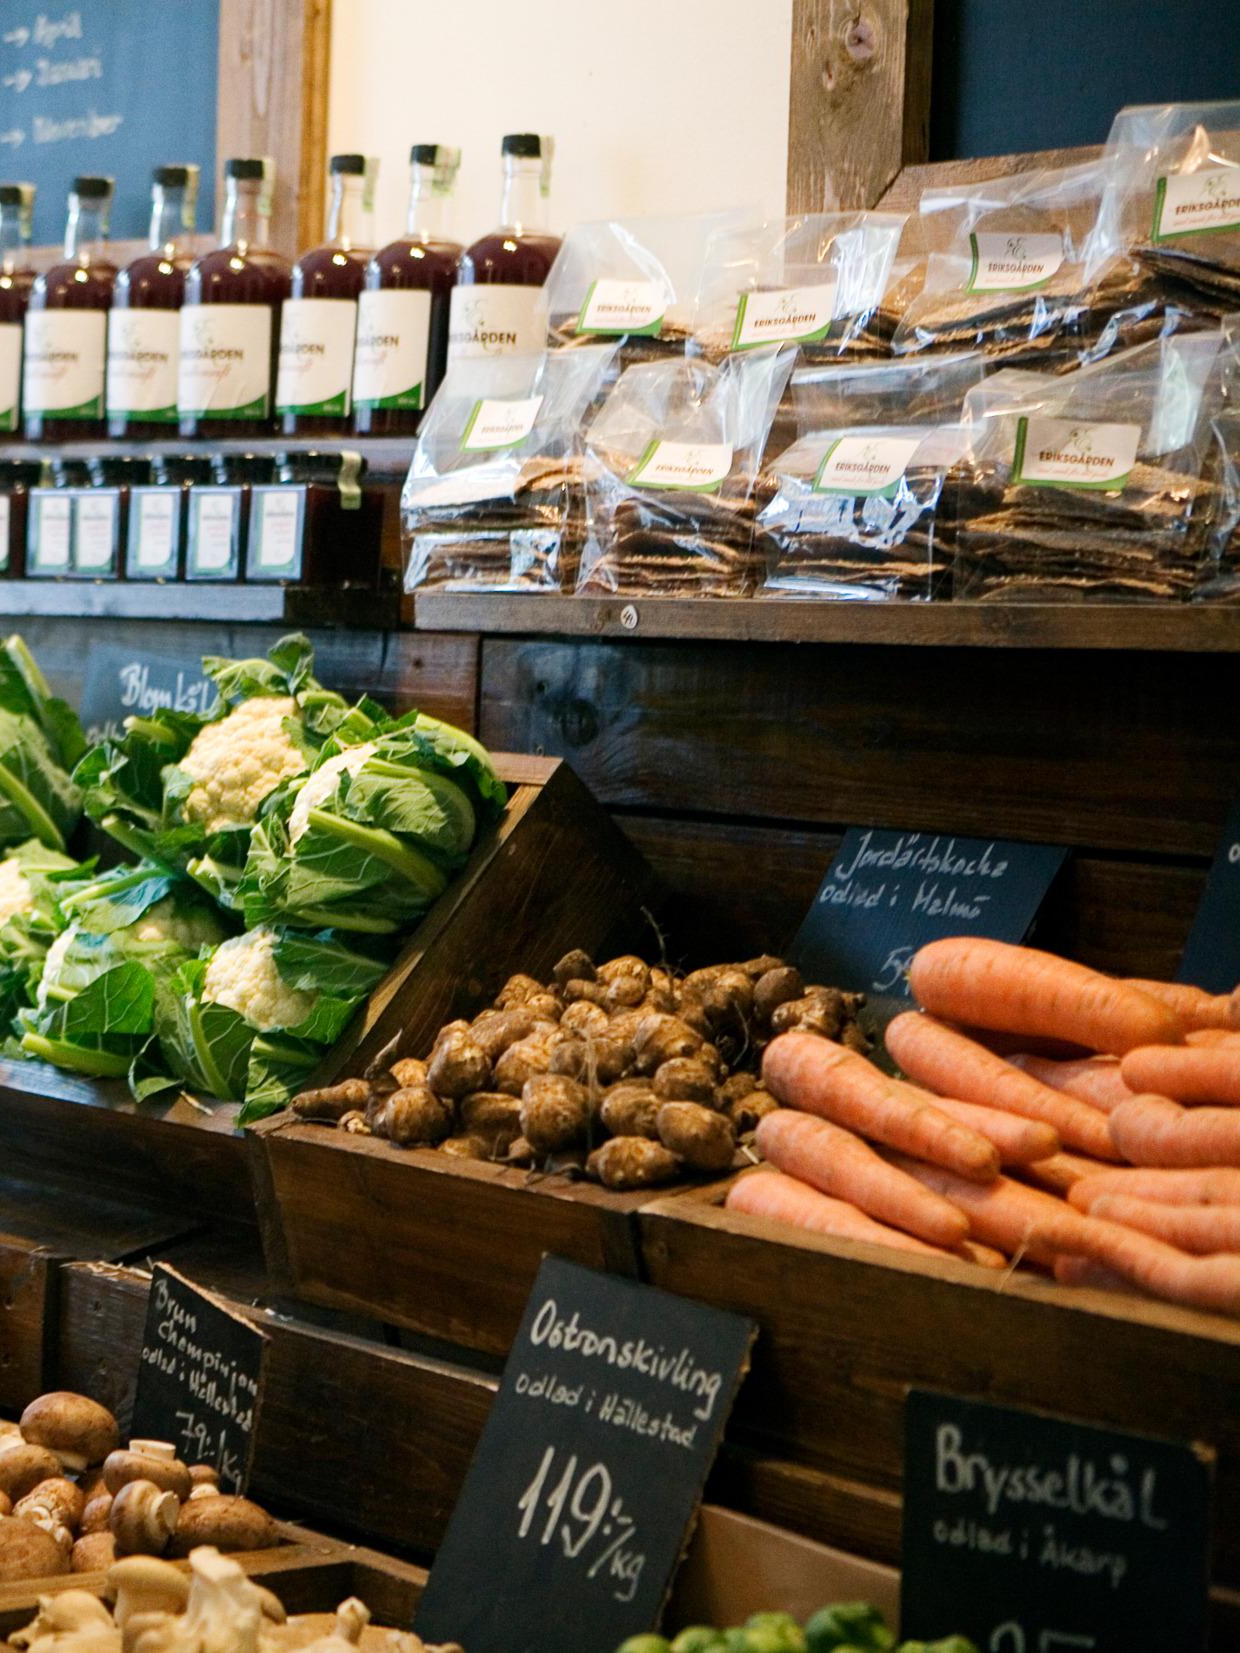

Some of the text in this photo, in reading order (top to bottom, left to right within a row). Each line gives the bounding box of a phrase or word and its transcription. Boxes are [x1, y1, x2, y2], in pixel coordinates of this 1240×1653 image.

[835, 461, 891, 474] ERIKSGÅRDEN
[1039, 450, 1115, 468] ERIKSGÅRDEN
[889, 884, 901, 907] i
[154, 1277, 197, 1335] Brun
[529, 1298, 723, 1422] Ostronskivling
[584, 1390, 596, 1414] i
[598, 1392, 698, 1450] Hällestad
[1019, 1528, 1031, 1561] i
